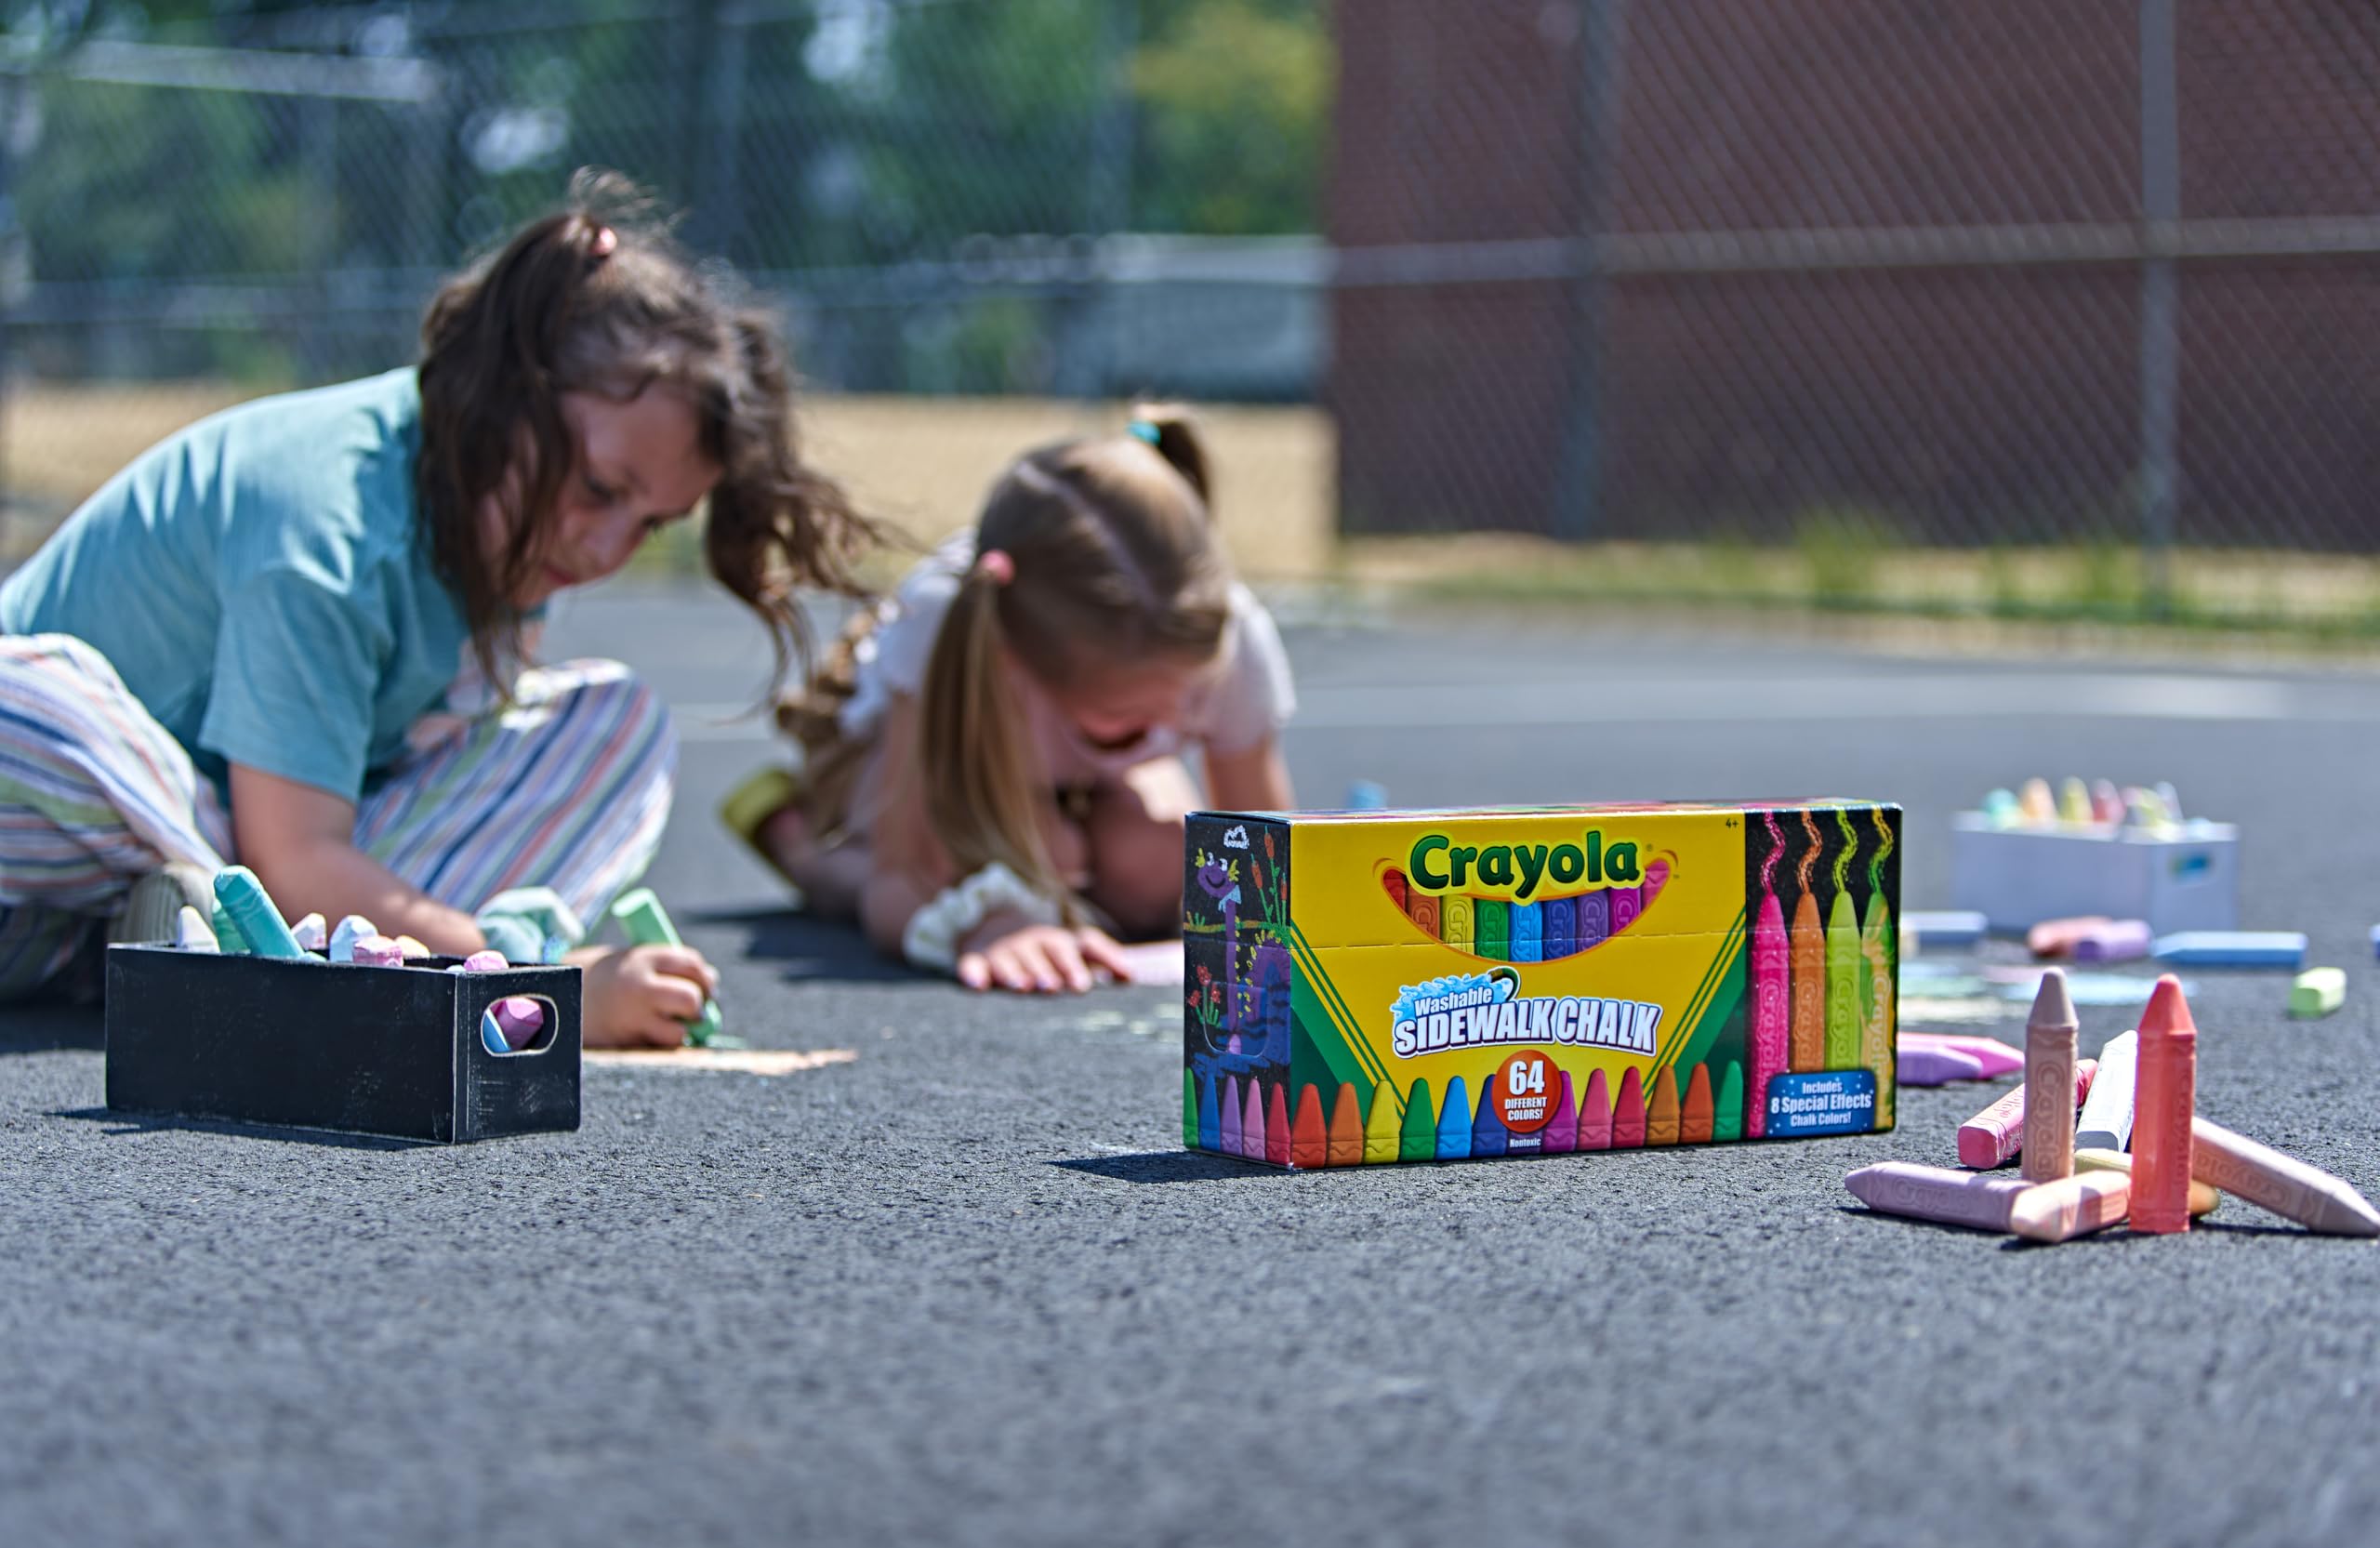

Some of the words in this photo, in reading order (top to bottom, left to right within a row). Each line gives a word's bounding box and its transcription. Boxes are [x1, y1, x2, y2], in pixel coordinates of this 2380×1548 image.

[1726, 818, 1739, 828] 4+
[1410, 830, 1640, 899] Crayola
[1414, 986, 1492, 1016] Washable
[1395, 999, 1556, 1054] SIDEWALK
[1556, 998, 1660, 1052] CHALK
[1831, 979, 1853, 1066] Crayol
[1509, 1060, 1544, 1095] 64
[1802, 1081, 1843, 1094] Includes
[1504, 1096, 1548, 1110] DIFFERENT
[1771, 1097, 1779, 1114] 8
[1781, 1094, 1828, 1114] Special
[1831, 1093, 1871, 1110] Effects
[1507, 1109, 1543, 1121] COLORS!
[1791, 1114, 1817, 1127] Chalk
[1819, 1112, 1851, 1125] Colors!
[1510, 1138, 1540, 1148] Nontoxic
